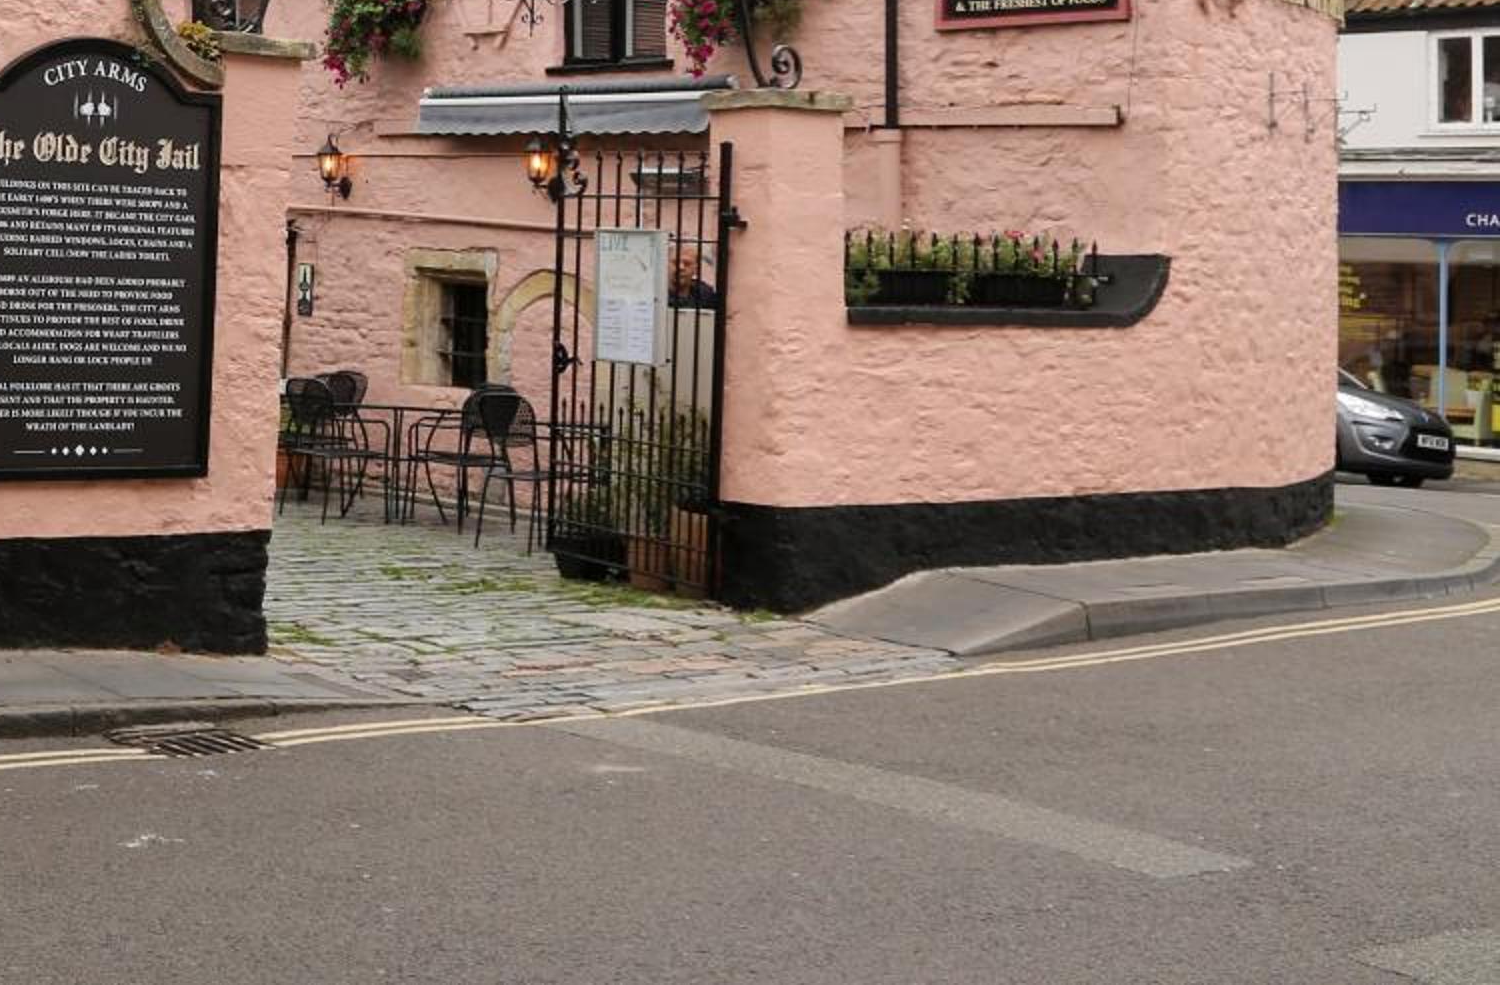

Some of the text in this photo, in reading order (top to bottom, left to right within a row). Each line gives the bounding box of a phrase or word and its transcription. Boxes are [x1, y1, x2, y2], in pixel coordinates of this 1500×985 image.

[969, 0, 992, 12] THE
[43, 60, 148, 92] CITY ARMS
[32, 131, 92, 164] Olde
[98, 136, 150, 174] City
[155, 137, 200, 171] Jail
[8, 194, 35, 203] EARLY
[164, 201, 181, 209] AND
[10, 220, 29, 230] AND
[66, 222, 90, 232] MANY
[4, 246, 44, 257] SOLITARY
[27, 288, 46, 297] OUT
[137, 304, 158, 313] CITY
